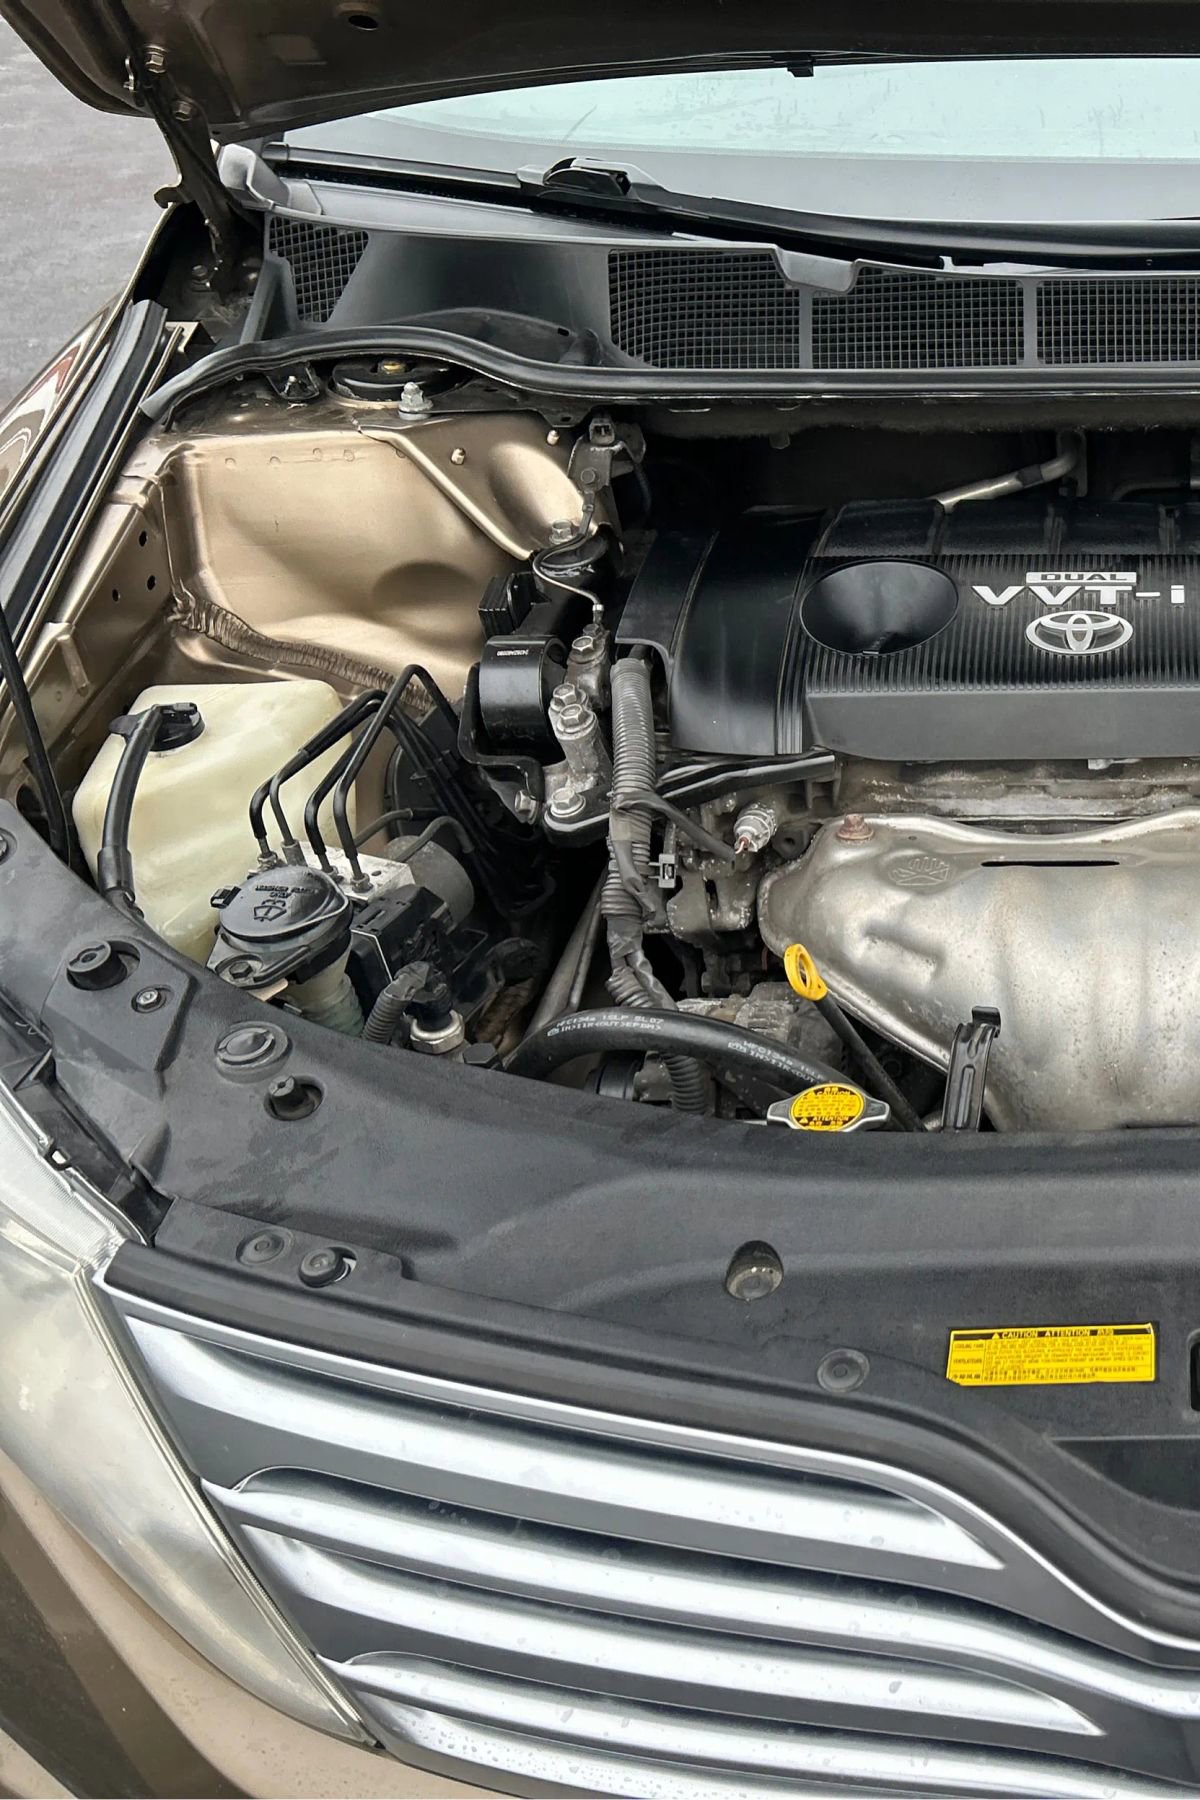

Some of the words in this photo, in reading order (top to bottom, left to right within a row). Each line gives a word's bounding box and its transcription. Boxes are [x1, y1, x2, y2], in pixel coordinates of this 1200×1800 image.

[1041, 573, 1127, 581] DUAL
[972, 585, 1185, 605] VVT-i
[1044, 1329, 1091, 1337] ATTENTION
